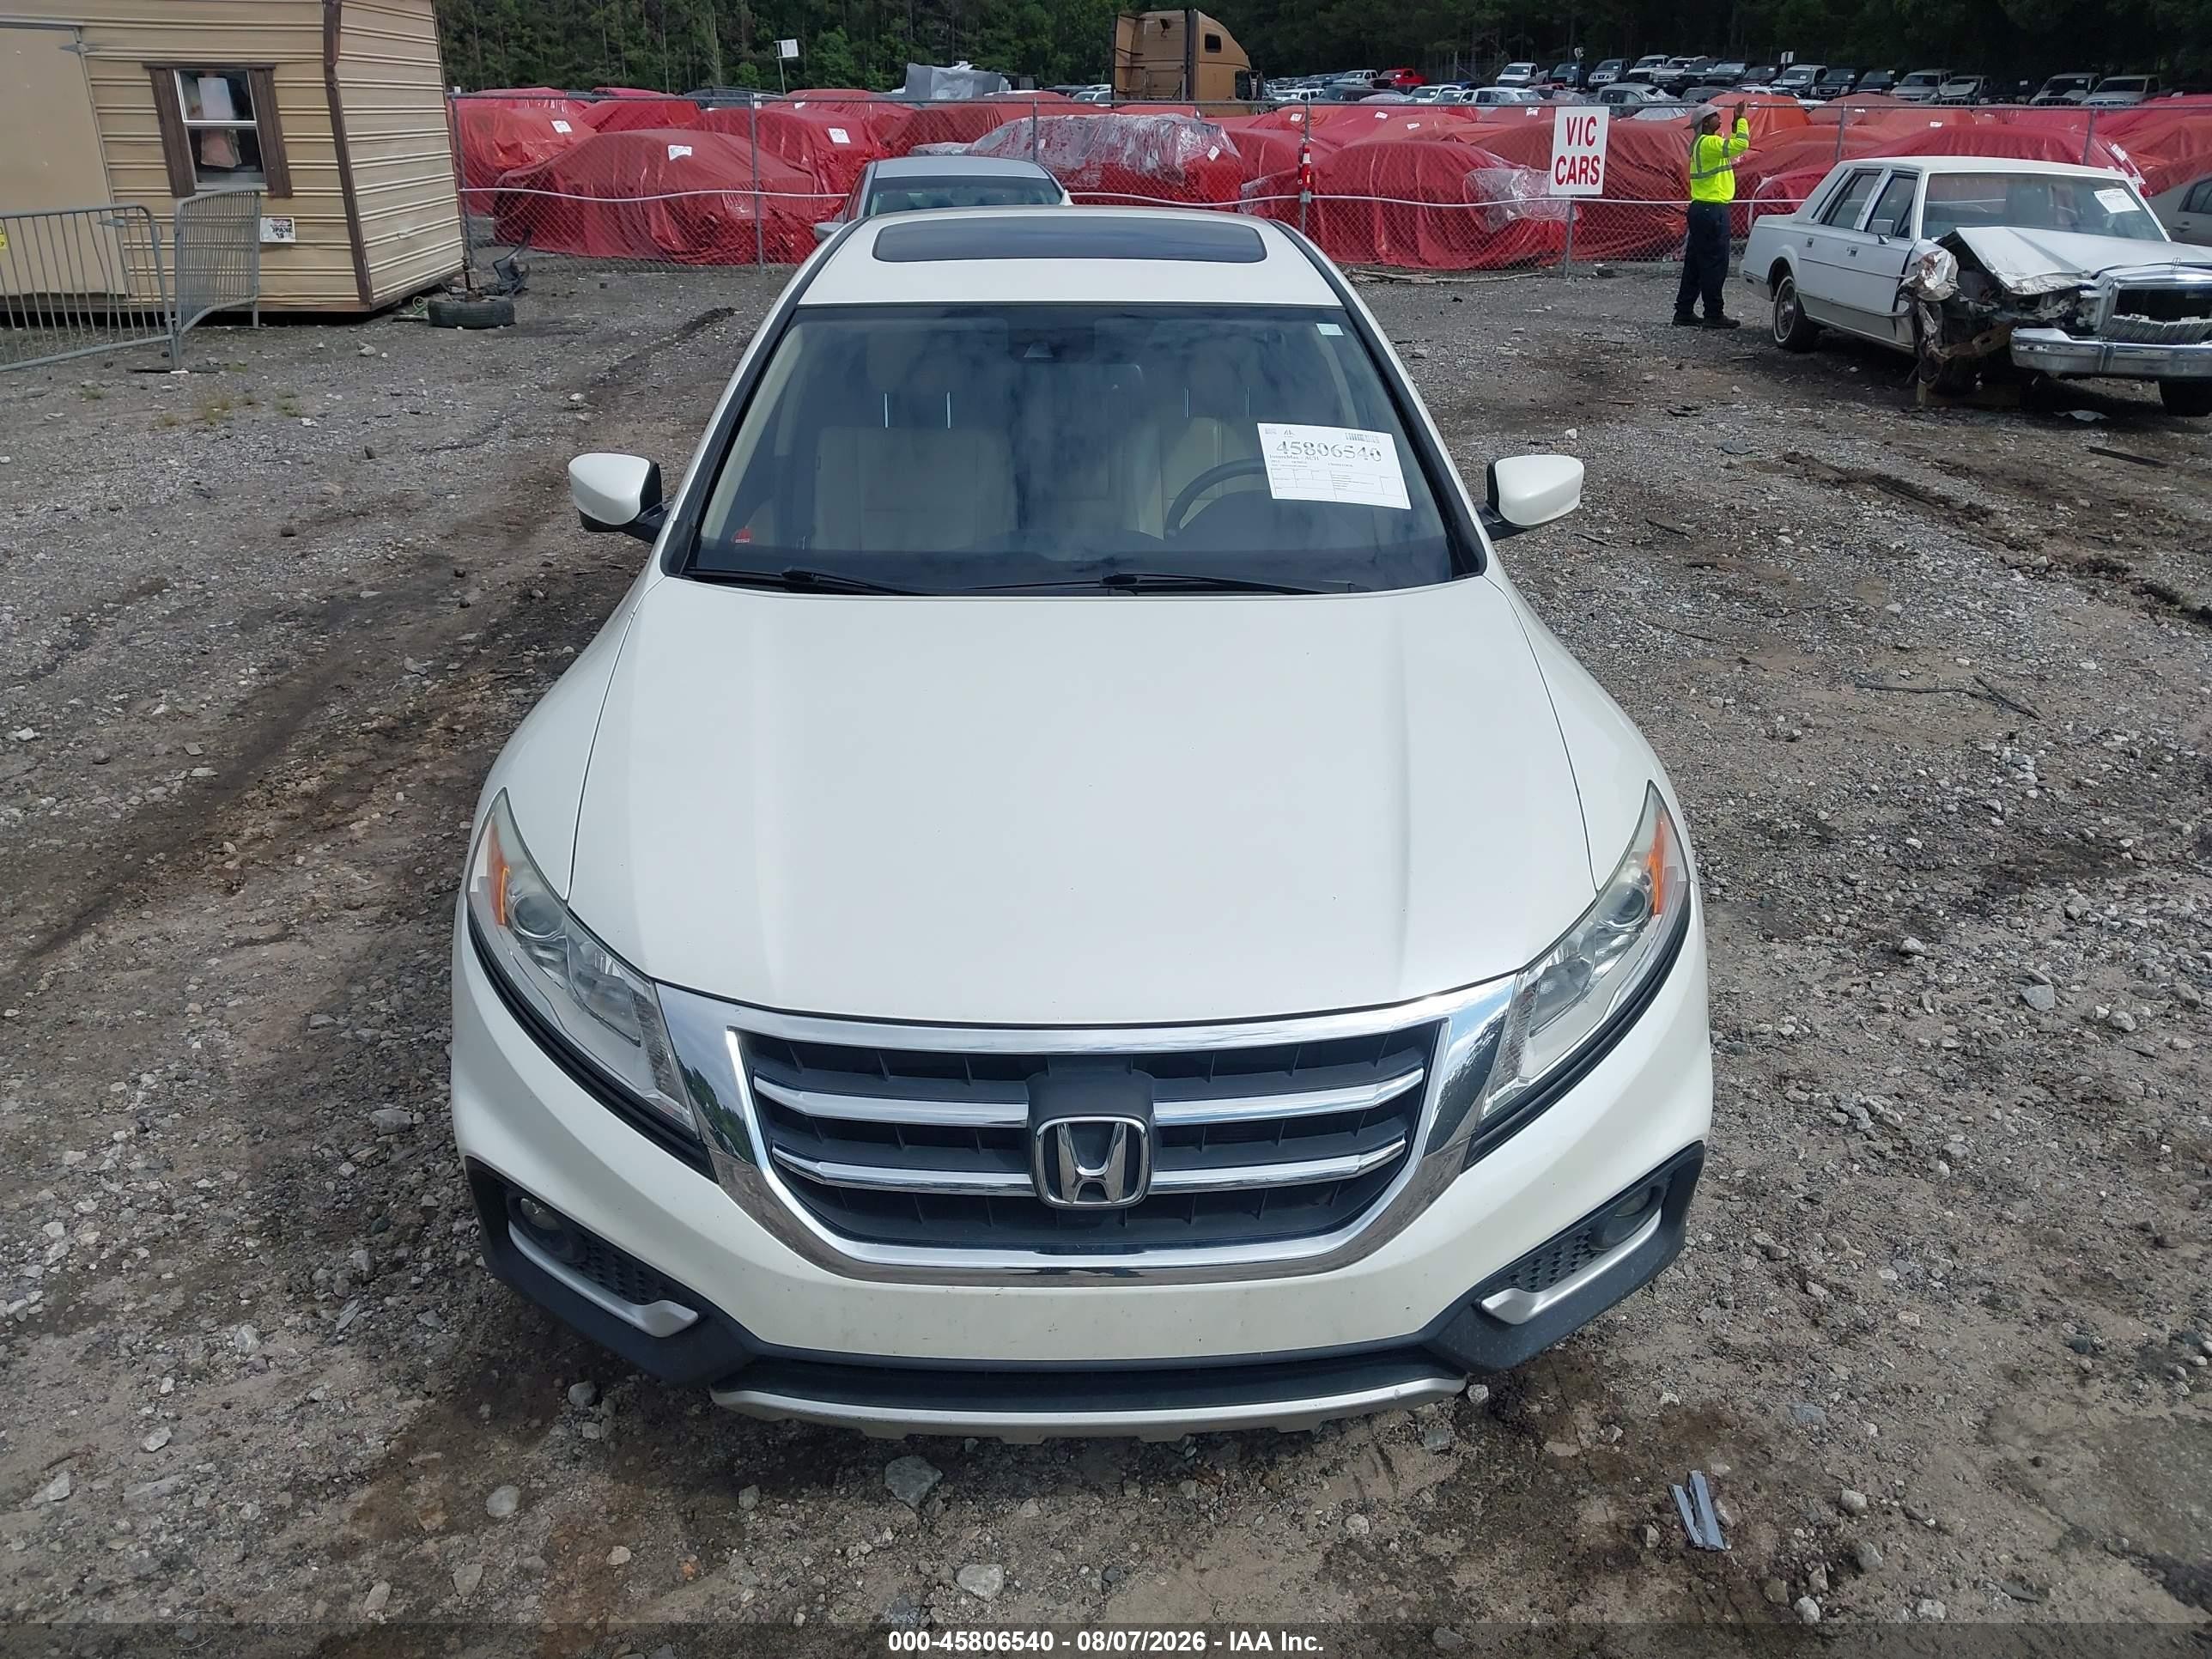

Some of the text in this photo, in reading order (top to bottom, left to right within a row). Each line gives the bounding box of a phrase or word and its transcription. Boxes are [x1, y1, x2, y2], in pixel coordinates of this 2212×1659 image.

[1566, 116, 1597, 147] VIC
[1555, 155, 1601, 185] CARS
[1277, 441, 1382, 462] 45806540
